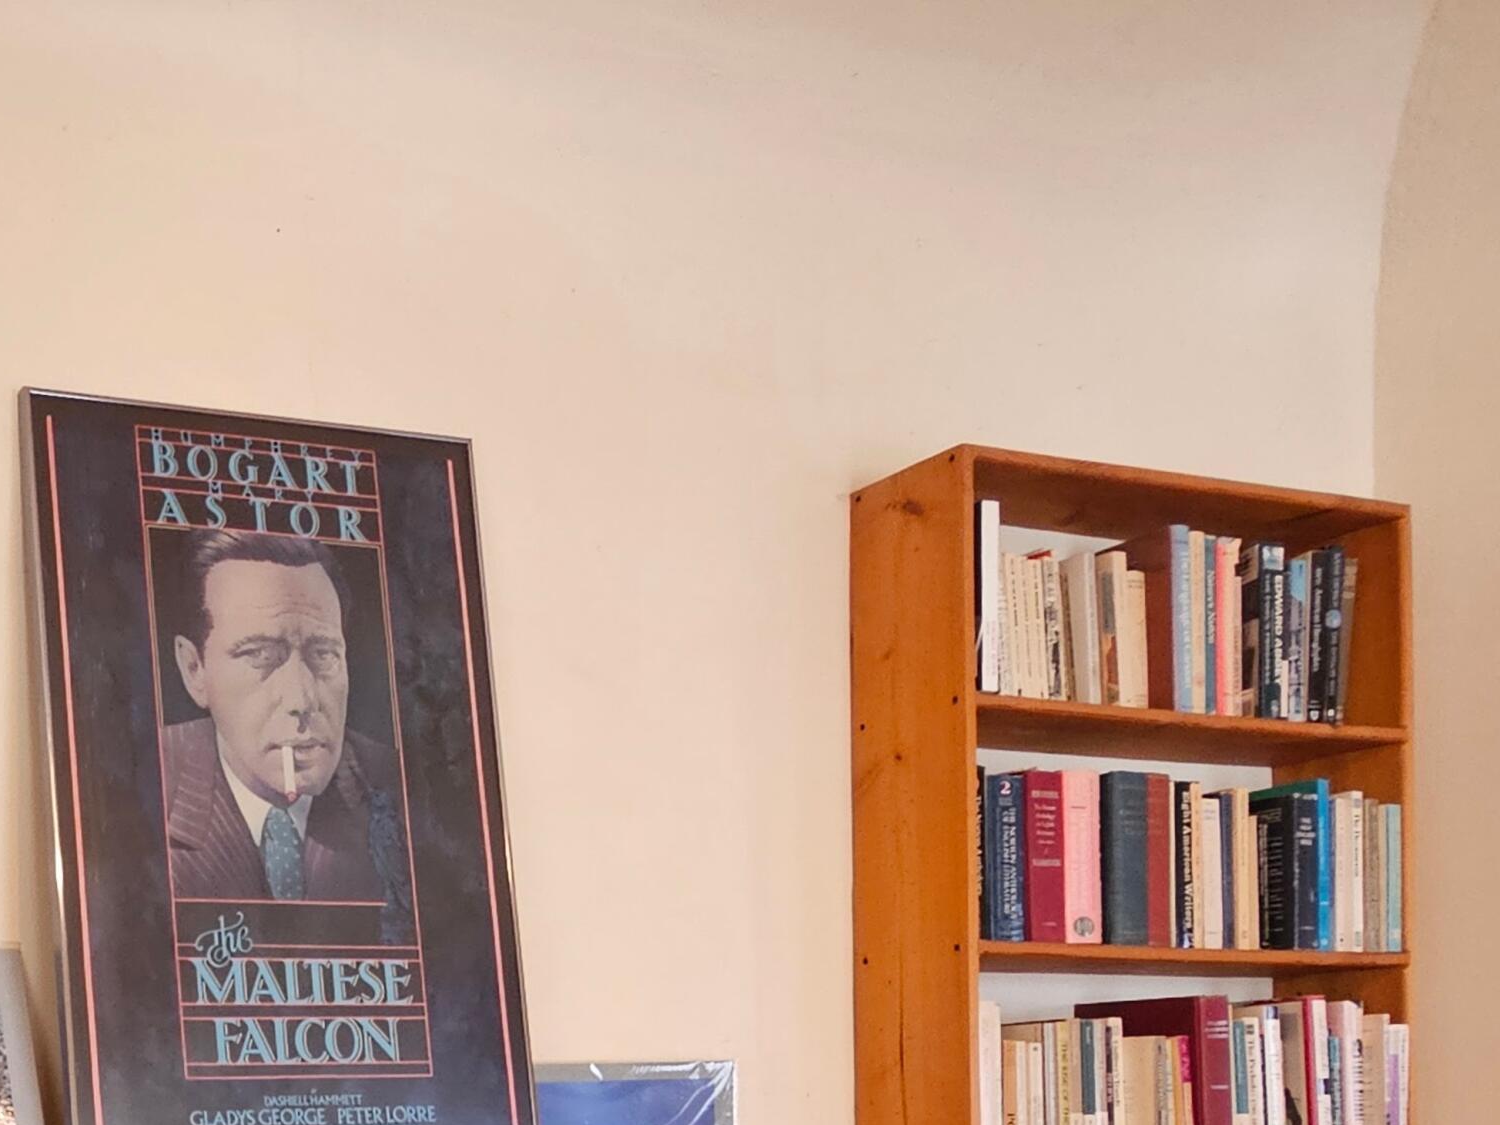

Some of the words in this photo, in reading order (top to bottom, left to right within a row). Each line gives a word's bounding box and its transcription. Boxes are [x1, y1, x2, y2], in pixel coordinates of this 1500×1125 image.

[152, 428, 360, 462] HUMPHREY
[152, 440, 360, 496] BOGART
[209, 481, 314, 501] MARY
[157, 489, 369, 543] ASTOR
[1274, 575, 1283, 636] EDWARD
[1274, 639, 1284, 685] ABBEY
[1182, 792, 1192, 823] Eight
[1182, 825, 1193, 883] American
[191, 959, 413, 1005] MALTESE
[213, 1017, 400, 1065] FALCON
[258, 1108, 326, 1125] GEORGE
[338, 1107, 381, 1125] PETER
[387, 1105, 436, 1123] LORRE
[264, 1096, 310, 1107] DASHIELL
[311, 1094, 362, 1106] HAMMETT
